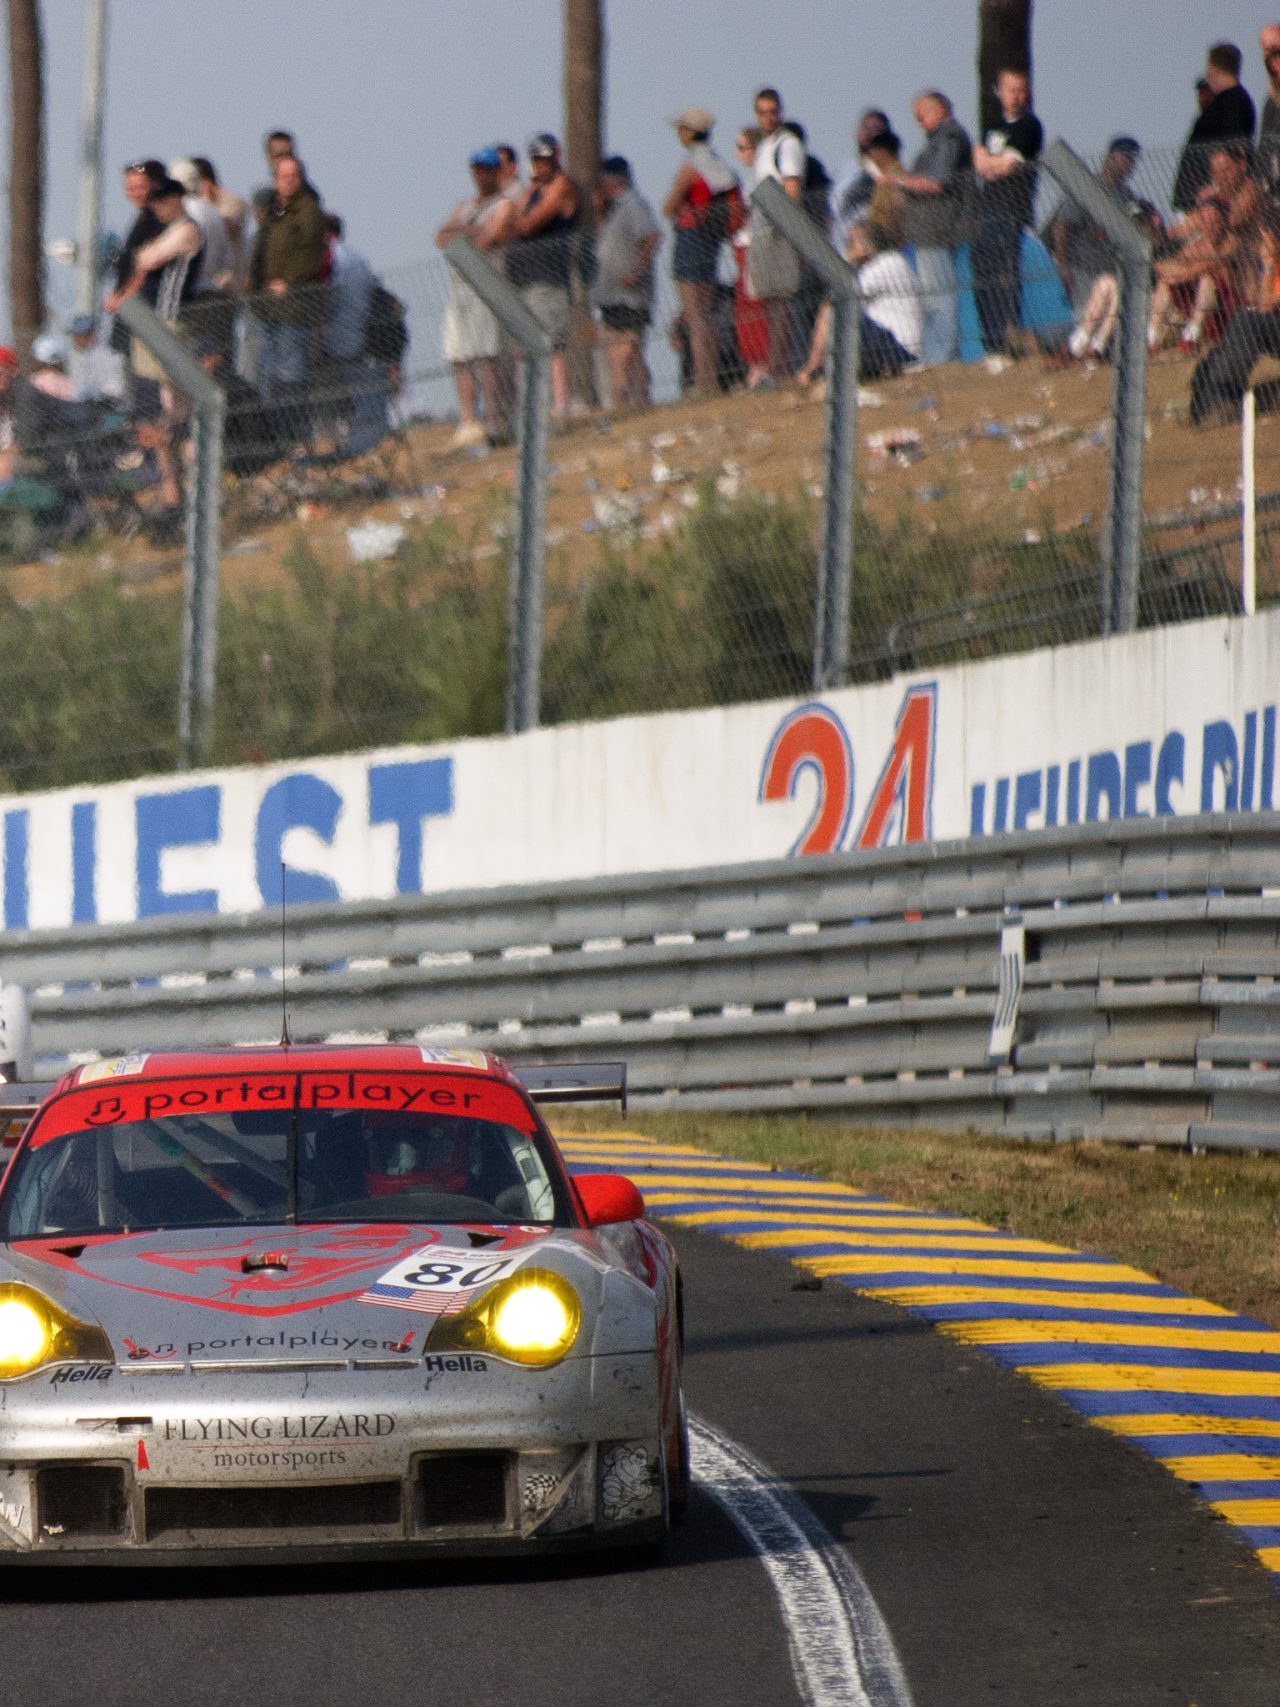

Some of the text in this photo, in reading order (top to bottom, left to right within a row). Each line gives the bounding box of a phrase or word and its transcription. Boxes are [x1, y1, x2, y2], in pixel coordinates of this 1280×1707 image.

[144, 1070, 481, 1119] portalplayer
[403, 1257, 514, 1287] 80
[187, 1331, 394, 1355] portalplayer
[49, 1365, 114, 1385] Hella
[426, 1355, 489, 1373] Hella
[163, 1412, 396, 1442] FLYING LIZARD
[214, 1449, 347, 1470] motorsports
